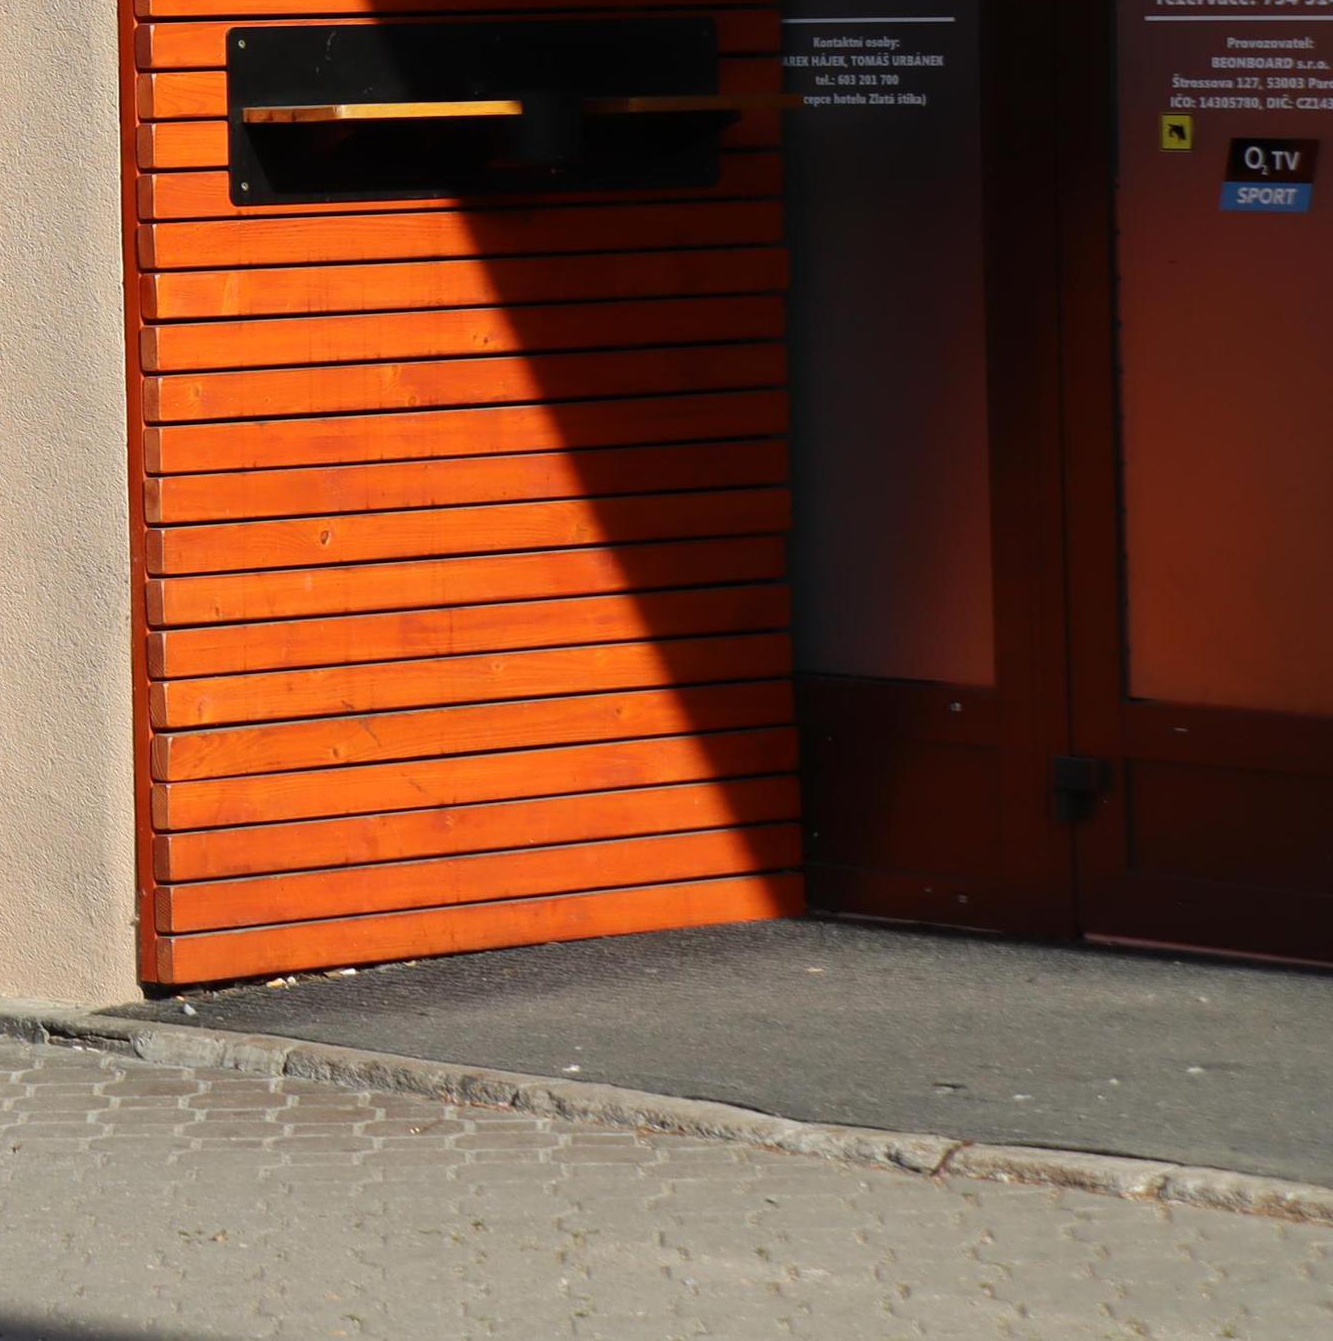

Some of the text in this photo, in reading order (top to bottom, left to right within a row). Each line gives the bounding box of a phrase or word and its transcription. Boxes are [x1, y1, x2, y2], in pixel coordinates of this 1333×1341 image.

[1226, 37, 1315, 49] Provozovatel:
[851, 52, 889, 67] TOMÁŠ
[892, 52, 944, 67] URBÁNEK
[1211, 56, 1331, 69] BEONBOARD s.r.o.
[837, 75, 856, 85] 603
[858, 75, 877, 85] 201
[1172, 73, 1233, 88] Štrossova
[1236, 77, 1264, 90] 127,
[1266, 77, 1305, 89] 53003
[1170, 93, 1196, 108] IČO:
[1266, 93, 1293, 109] DIČ:
[1271, 151, 1301, 171] TV
[1236, 187, 1298, 205] SPORT
